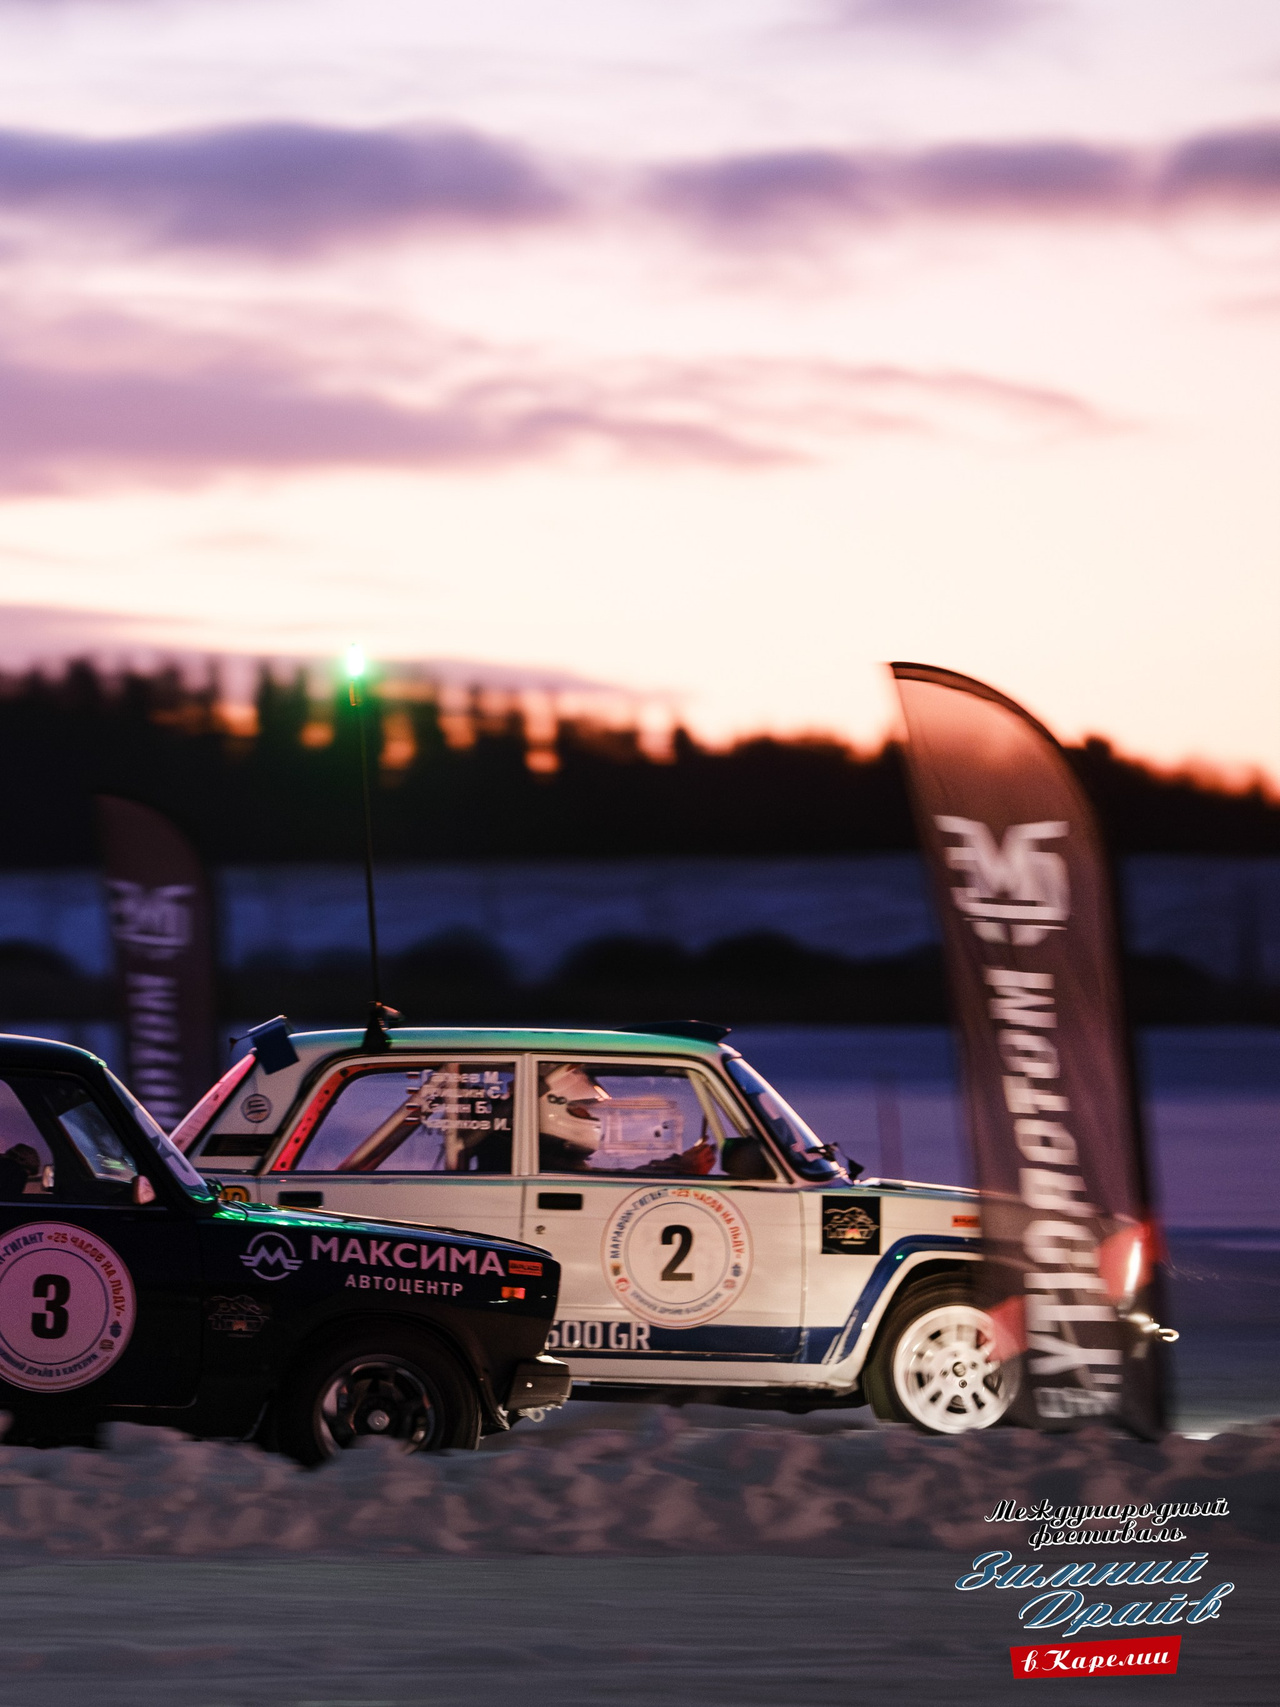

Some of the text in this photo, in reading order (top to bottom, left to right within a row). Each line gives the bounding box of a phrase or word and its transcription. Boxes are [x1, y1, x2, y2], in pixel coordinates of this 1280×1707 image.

[310, 1234, 507, 1278] МАКСИМА
[661, 1224, 694, 1281] 2
[31, 1273, 71, 1340] 3
[344, 1273, 464, 1297] АВТОЦЕНТР
[608, 1321, 651, 1350] GR
